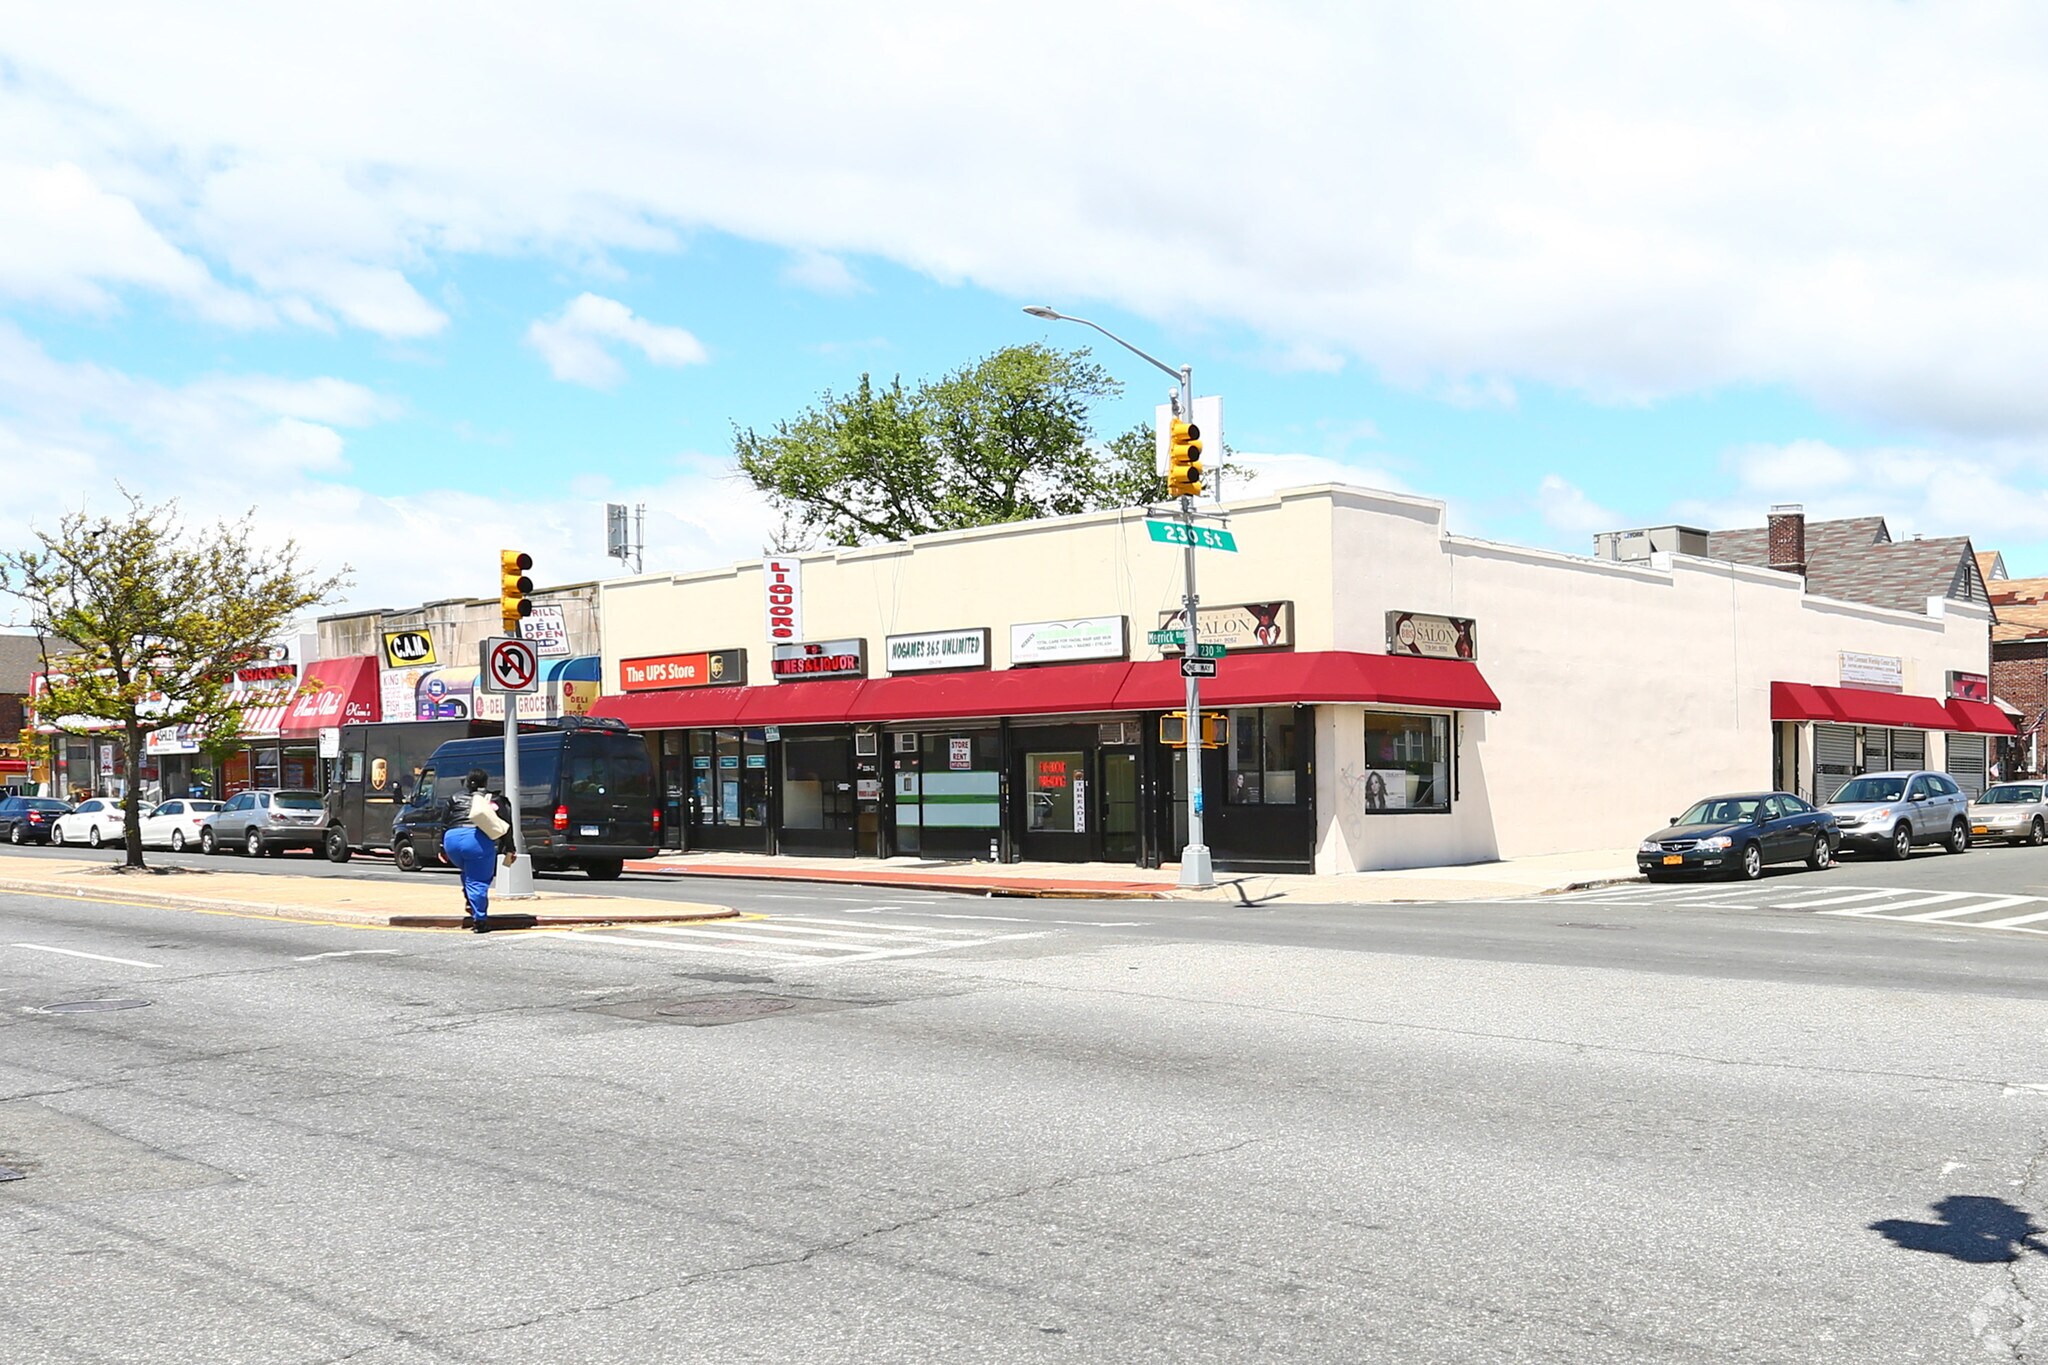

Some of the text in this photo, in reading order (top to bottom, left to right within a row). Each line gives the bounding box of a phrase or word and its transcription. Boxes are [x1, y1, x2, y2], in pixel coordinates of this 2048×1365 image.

[1163, 525, 1223, 547] 230 St
[768, 562, 795, 638] LIQUORS
[529, 608, 555, 617] RILL
[524, 622, 561, 632] DELI
[525, 630, 564, 640] OPEN
[1148, 631, 1174, 645] Merrick
[1416, 627, 1454, 642] SALON
[393, 635, 427, 658] C.A.M.
[892, 636, 980, 660] NOGAMES 365 UNLIMITED
[1200, 645, 1214, 657] 230
[383, 673, 399, 686] KING
[626, 663, 695, 683] The UPS Store
[489, 698, 505, 714] DEL
[519, 695, 556, 713] GROCERY
[570, 696, 588, 704] DELI
[149, 729, 175, 747] ASHLEY
[951, 741, 968, 749] STORE
[952, 752, 967, 760] RENT
